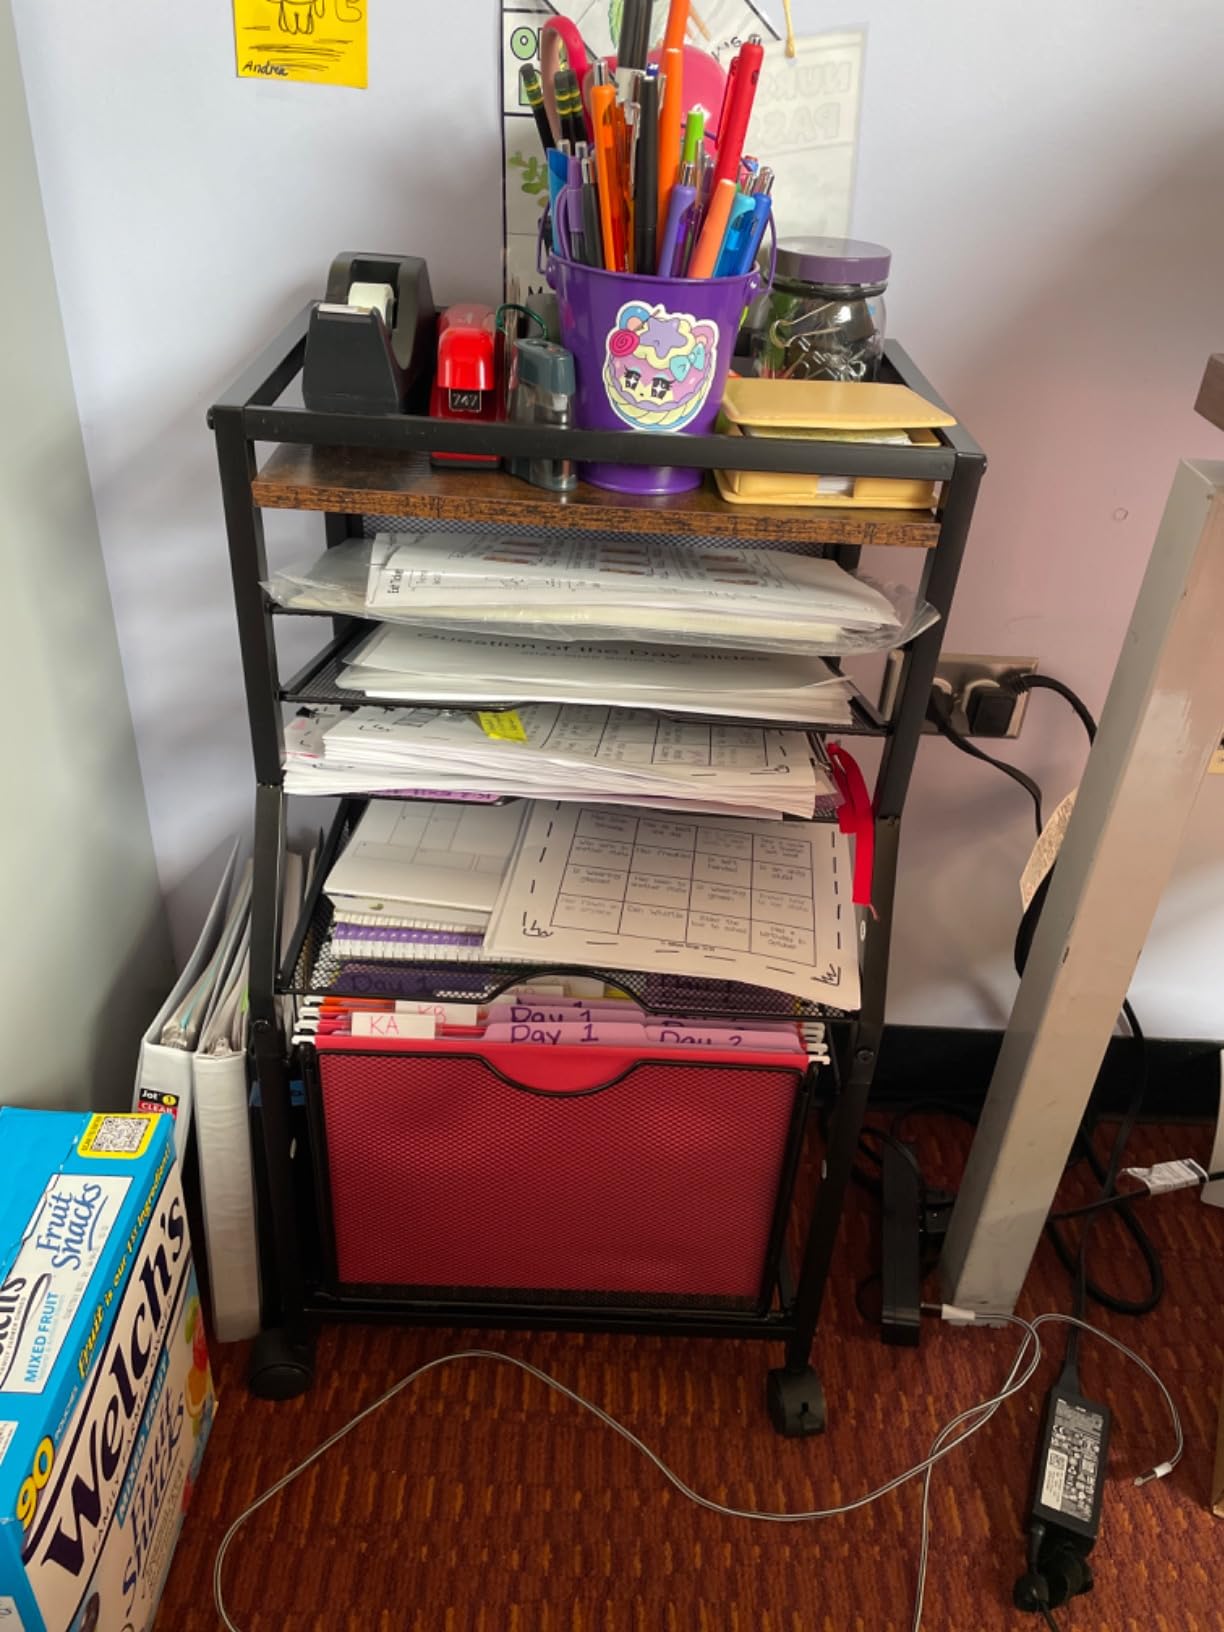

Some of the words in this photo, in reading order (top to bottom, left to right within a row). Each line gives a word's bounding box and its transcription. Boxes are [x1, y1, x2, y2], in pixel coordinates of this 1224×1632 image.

[242, 59, 289, 77] Andrea
[452, 392, 478, 406] 747
[369, 1015, 400, 1036] KA
[509, 1024, 562, 1046] Day
[579, 1023, 600, 1043] 1
[142, 1102, 174, 1113] CLEAR
[36, 1192, 73, 1252] Fruit
[51, 1183, 101, 1271] Snacks
[24, 1336, 47, 1383] MIXED
[38, 1291, 58, 1333] FRUIT
[78, 1304, 105, 1378] Fruit
[103, 1291, 114, 1307] is
[113, 1258, 128, 1288] our
[41, 1196, 186, 1577] Welch's
[16, 1435, 55, 1533] 90
